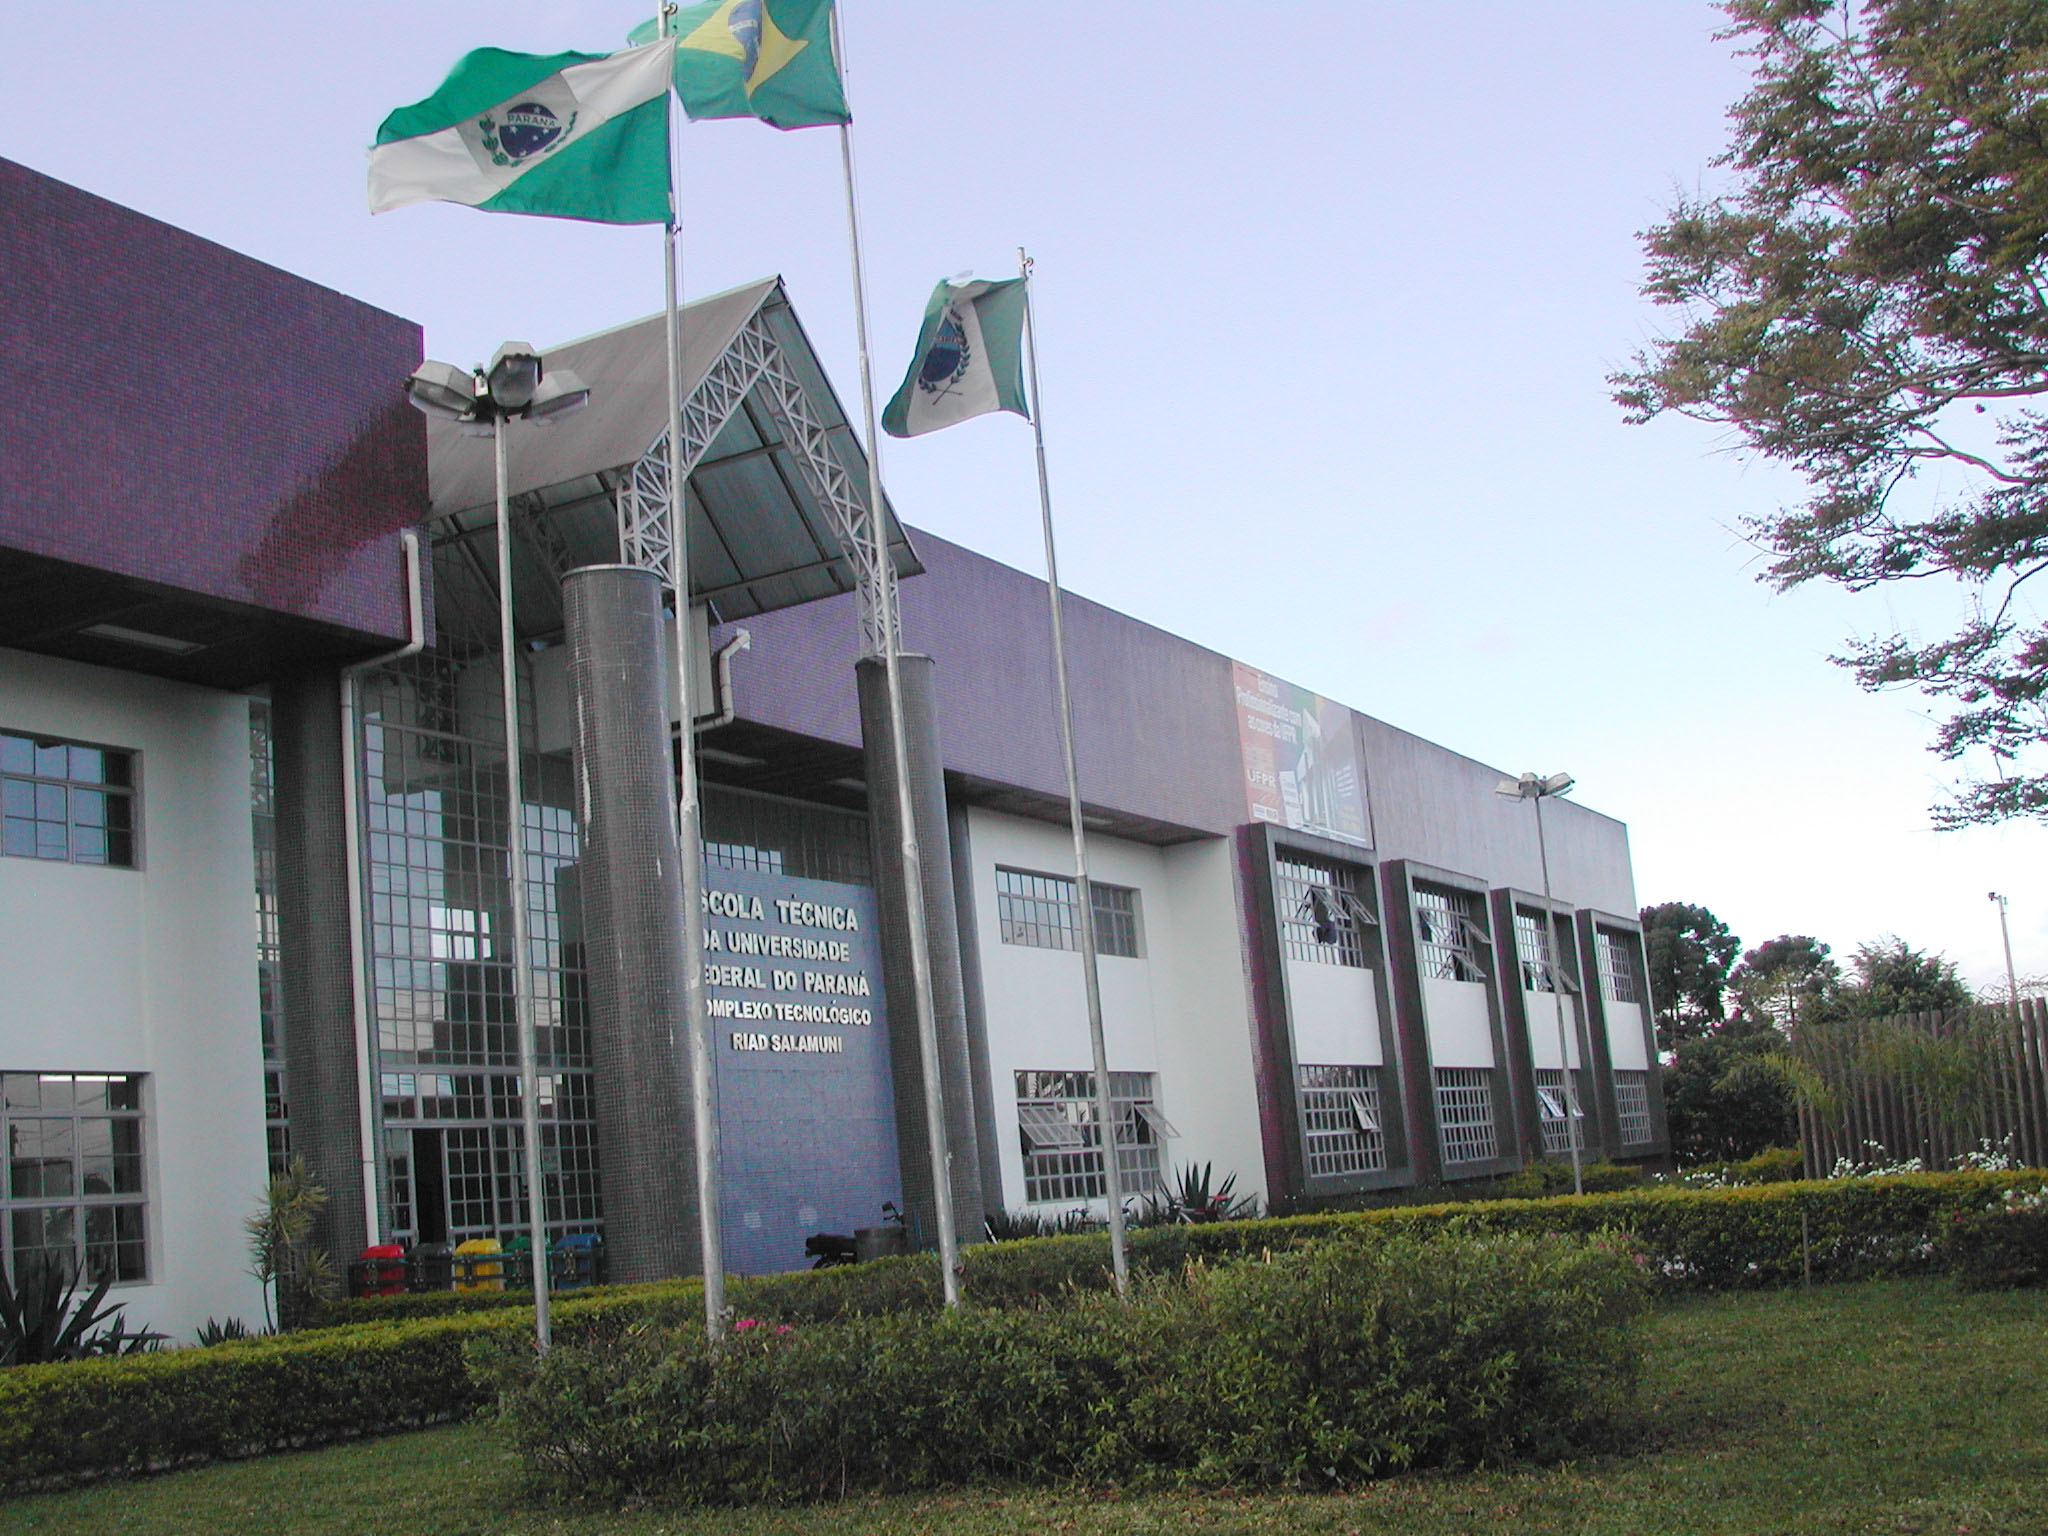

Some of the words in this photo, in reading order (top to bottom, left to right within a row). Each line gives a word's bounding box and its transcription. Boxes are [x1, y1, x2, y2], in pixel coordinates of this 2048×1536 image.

[1247, 769, 1277, 789] UFPR
[701, 889, 765, 921] SCOLA
[775, 893, 859, 931] TÉCNICA
[727, 931, 850, 962] UNIVERSIDADE
[705, 964, 767, 989] DERAL
[772, 970, 797, 991] DO
[804, 969, 871, 996] PARANÁ
[775, 1000, 872, 1026] TECNOLÓGICO
[732, 1032, 769, 1052] RIAD
[771, 1035, 843, 1053] SALAMUNI
